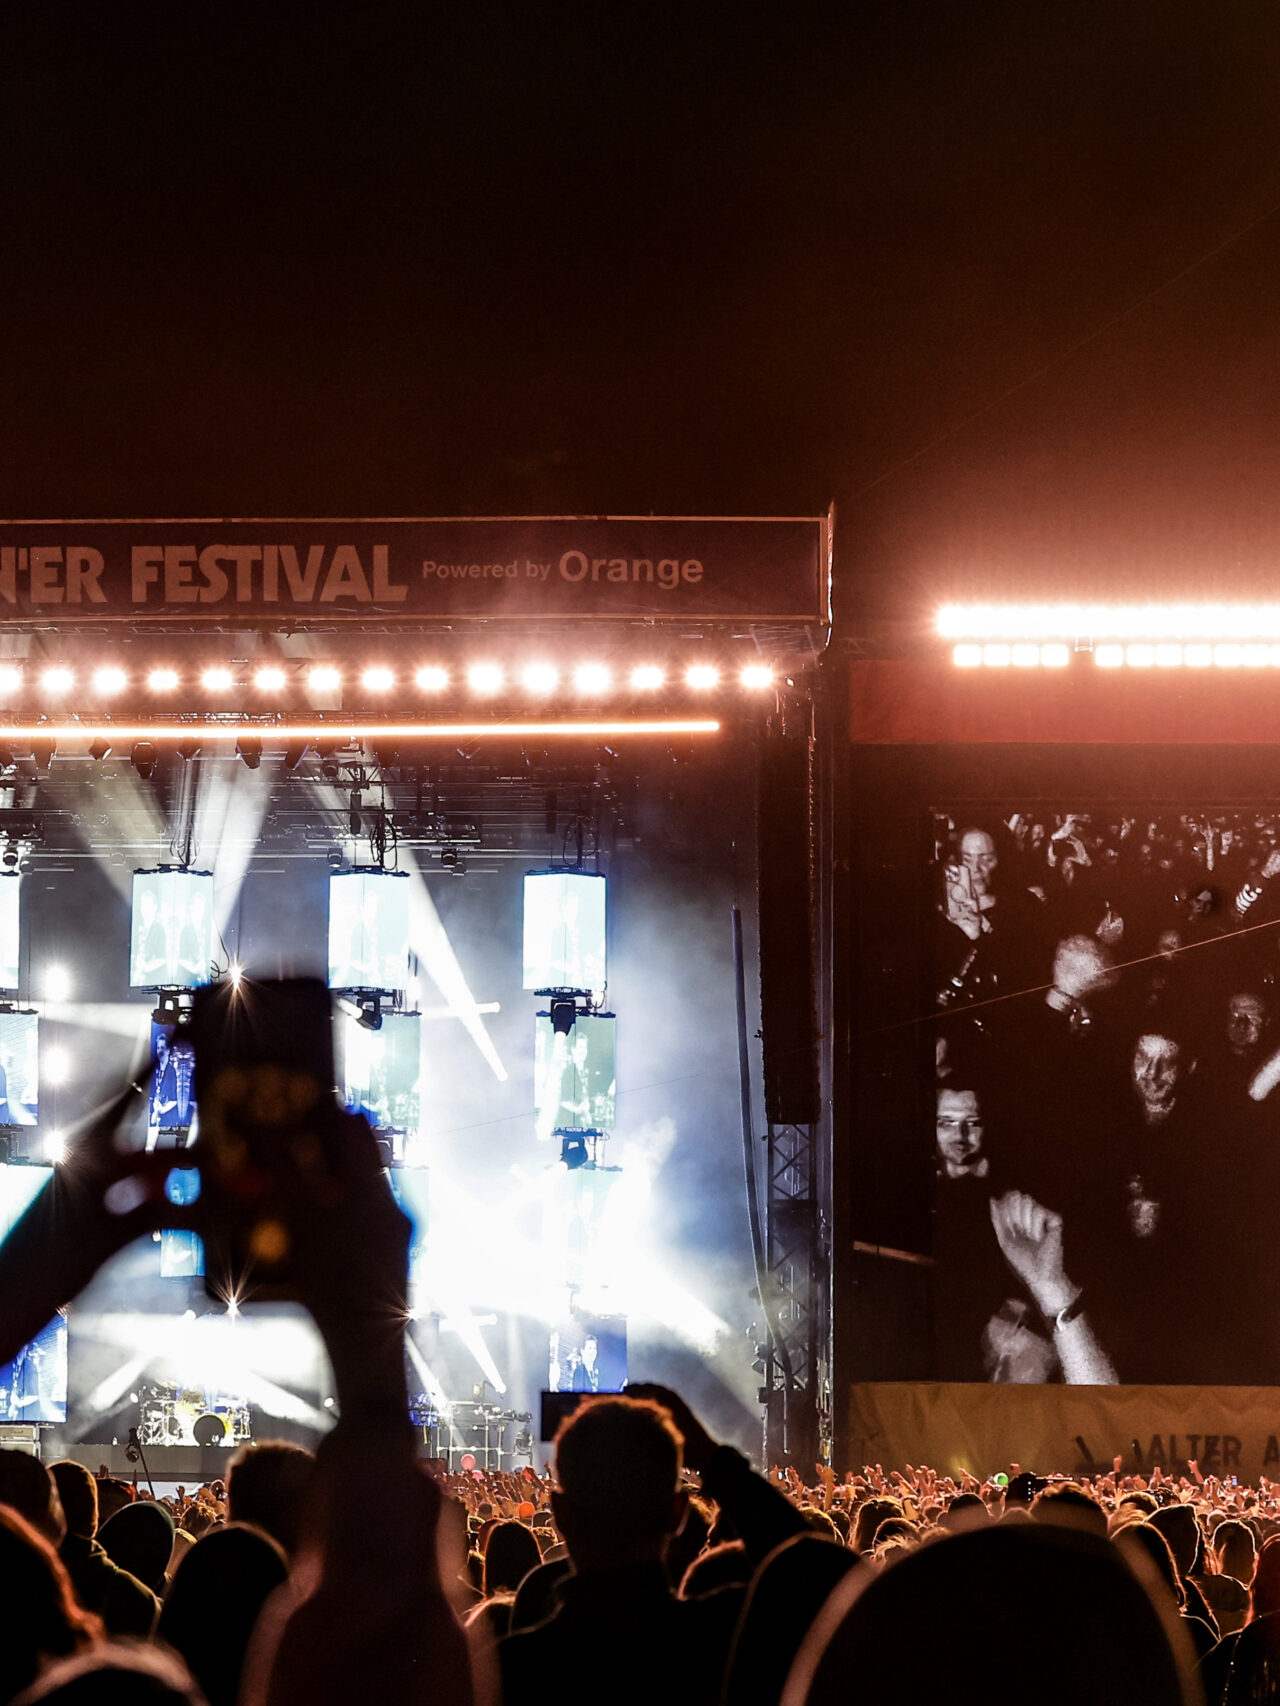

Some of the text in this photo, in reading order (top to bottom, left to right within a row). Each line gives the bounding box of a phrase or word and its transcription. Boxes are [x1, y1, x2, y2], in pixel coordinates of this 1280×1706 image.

[131, 544, 409, 604] FESTIVAL
[422, 560, 518, 578] Powered
[526, 560, 551, 581] by
[558, 550, 704, 590] Orange
[1148, 1434, 1243, 1467] ALTER
